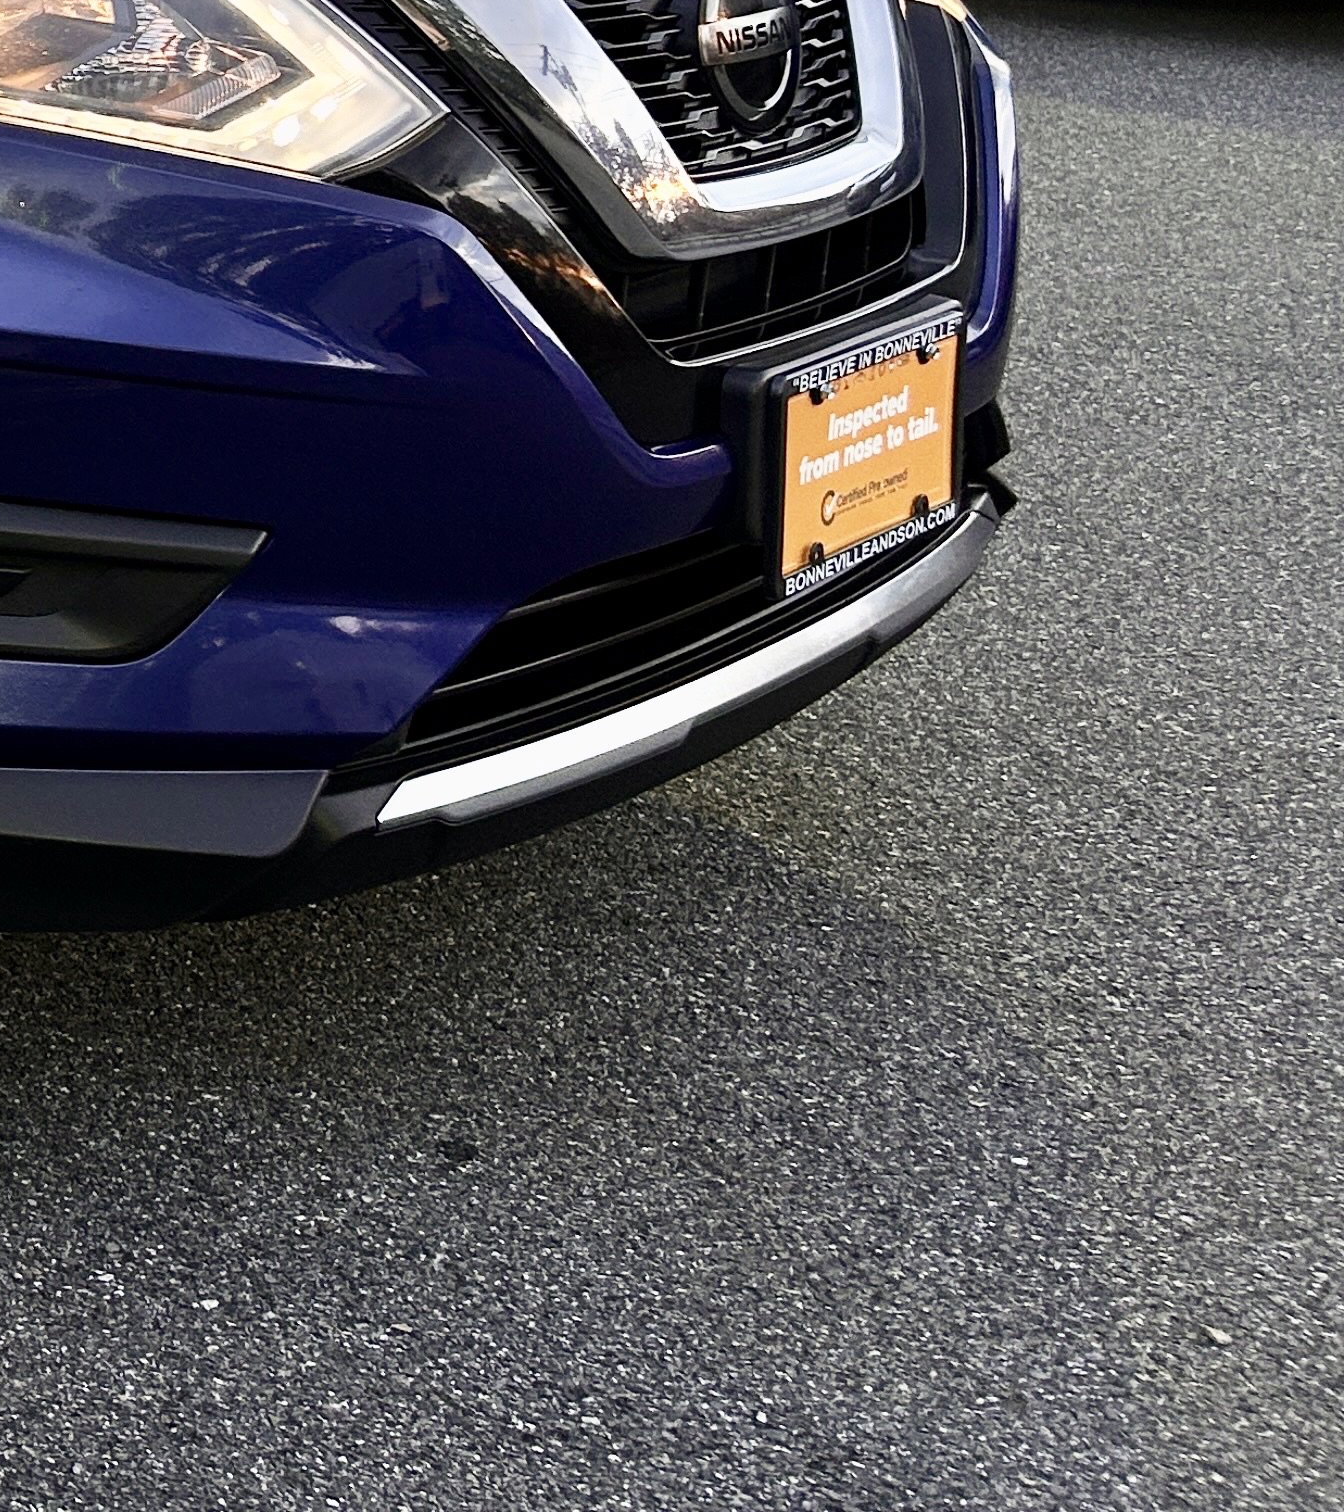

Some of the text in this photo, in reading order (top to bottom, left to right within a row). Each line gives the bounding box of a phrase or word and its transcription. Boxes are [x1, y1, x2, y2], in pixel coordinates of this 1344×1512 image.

[716, 16, 790, 54] NISSAN
[858, 351, 873, 370] IN
[828, 385, 910, 440] Inspected
[799, 407, 939, 485] from nose to tail.
[785, 503, 957, 597] BONNEVILLEANDSON.COM
